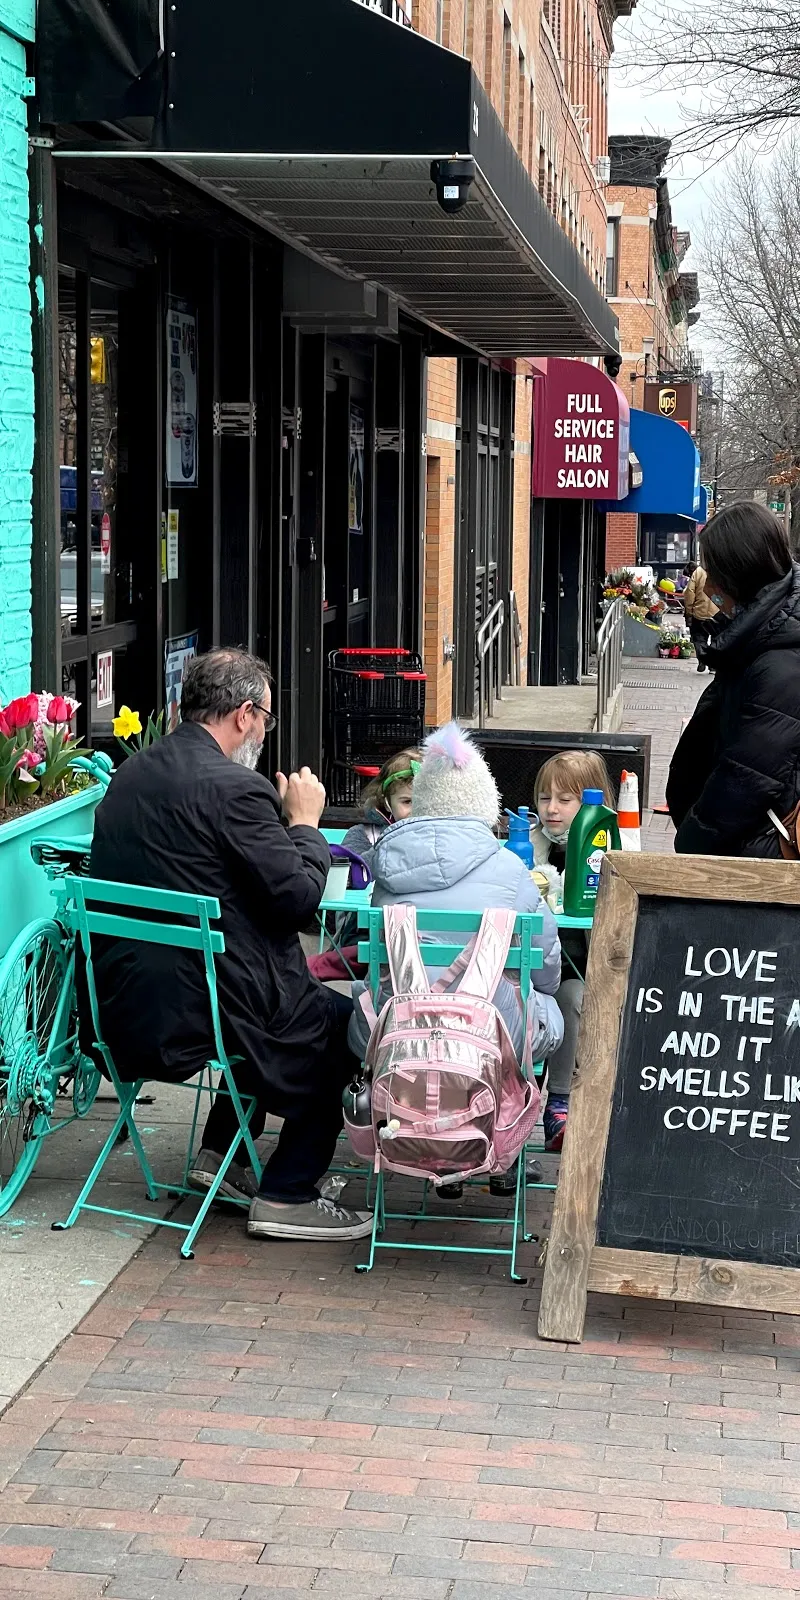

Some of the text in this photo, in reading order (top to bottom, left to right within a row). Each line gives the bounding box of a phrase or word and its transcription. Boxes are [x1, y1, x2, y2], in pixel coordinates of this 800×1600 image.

[567, 394, 602, 413] FULL
[554, 419, 614, 438] SERVICE
[565, 444, 602, 463] HAIR
[557, 468, 609, 488] SALON
[98, 655, 112, 701] EXIT
[588, 857, 602, 865] Casc
[684, 946, 778, 982] LOVE
[635, 987, 663, 1013] IS
[678, 991, 702, 1018] IN
[720, 994, 774, 1025] THE
[660, 1031, 772, 1062] AND IT
[639, 1066, 750, 1098] SMELLS
[663, 1106, 791, 1142] COFFEE
